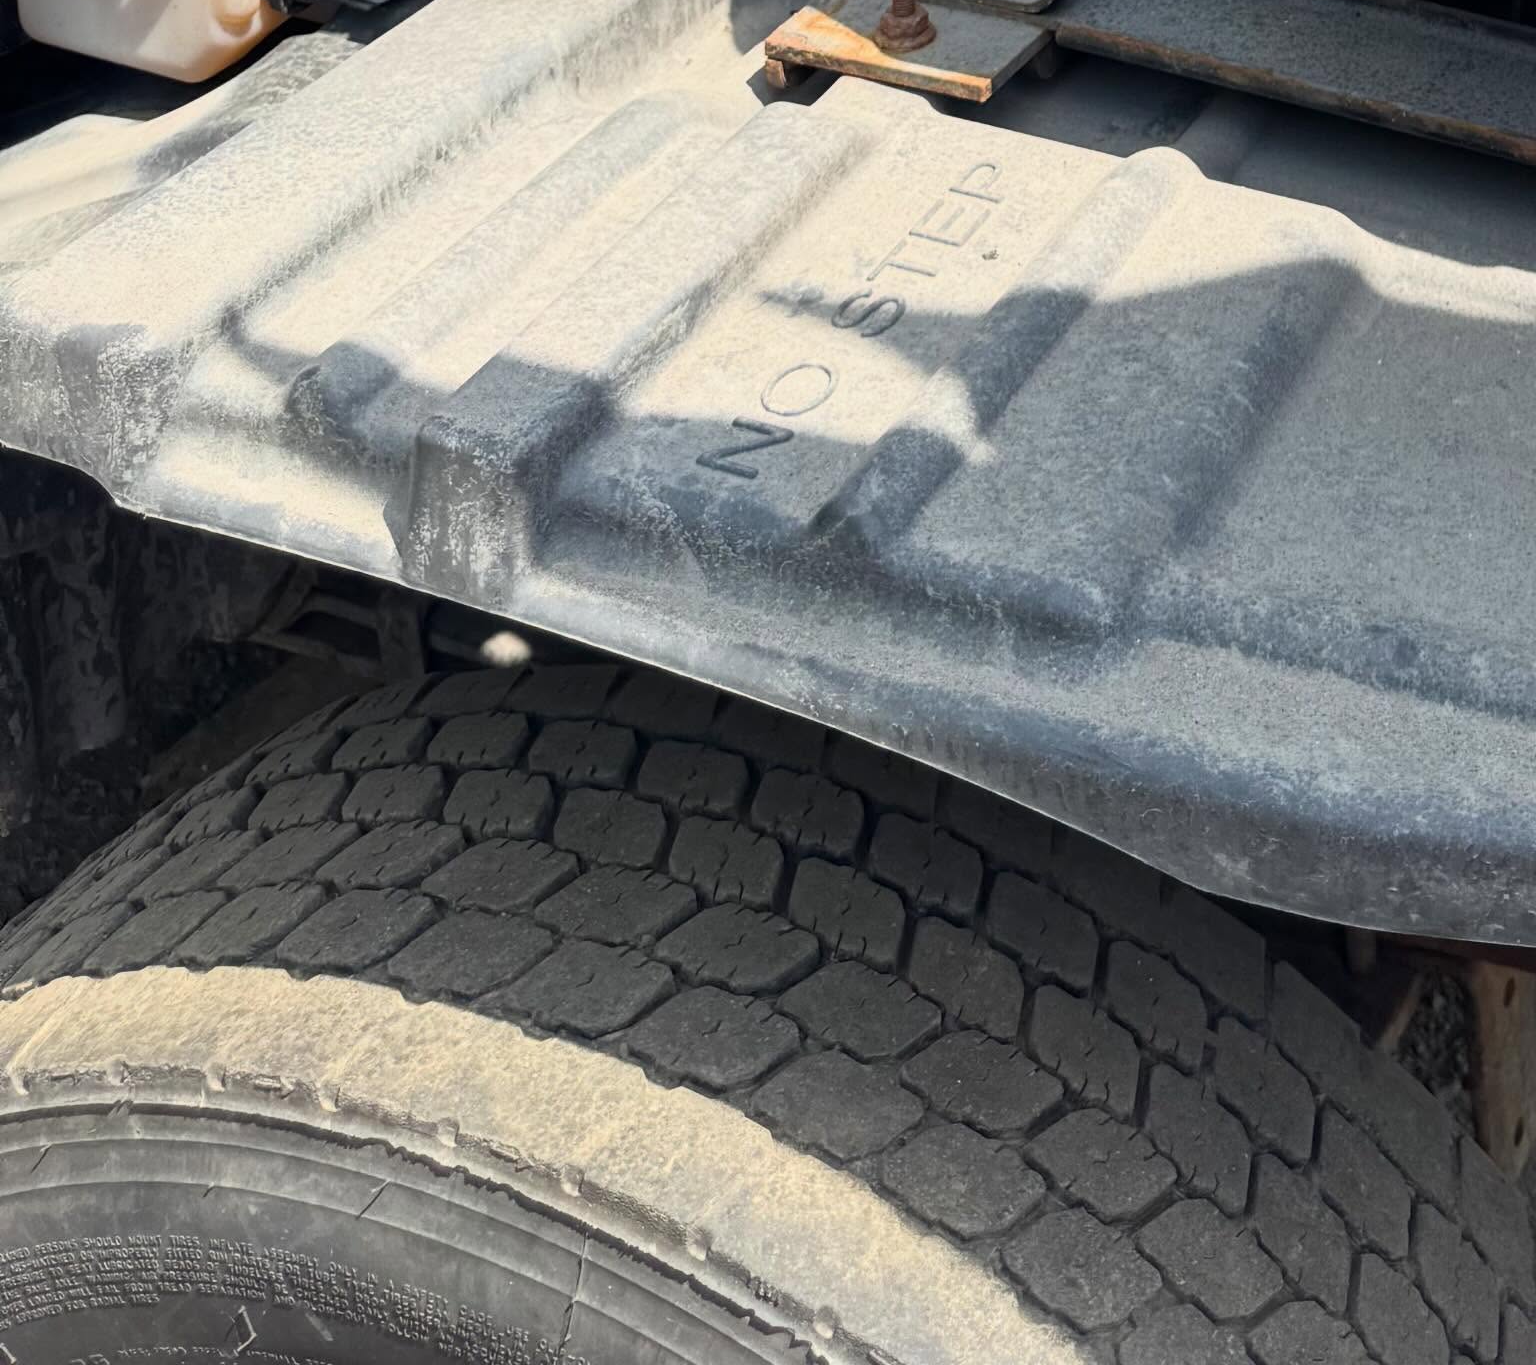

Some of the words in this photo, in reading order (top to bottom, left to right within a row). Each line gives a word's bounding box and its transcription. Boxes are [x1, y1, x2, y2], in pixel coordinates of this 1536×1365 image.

[695, 362, 840, 480] NO
[831, 160, 1004, 339] STEP
[82, 1235, 122, 1248] SHOULD
[128, 1234, 162, 1247] MOUNT
[166, 1247, 203, 1260] FITTED
